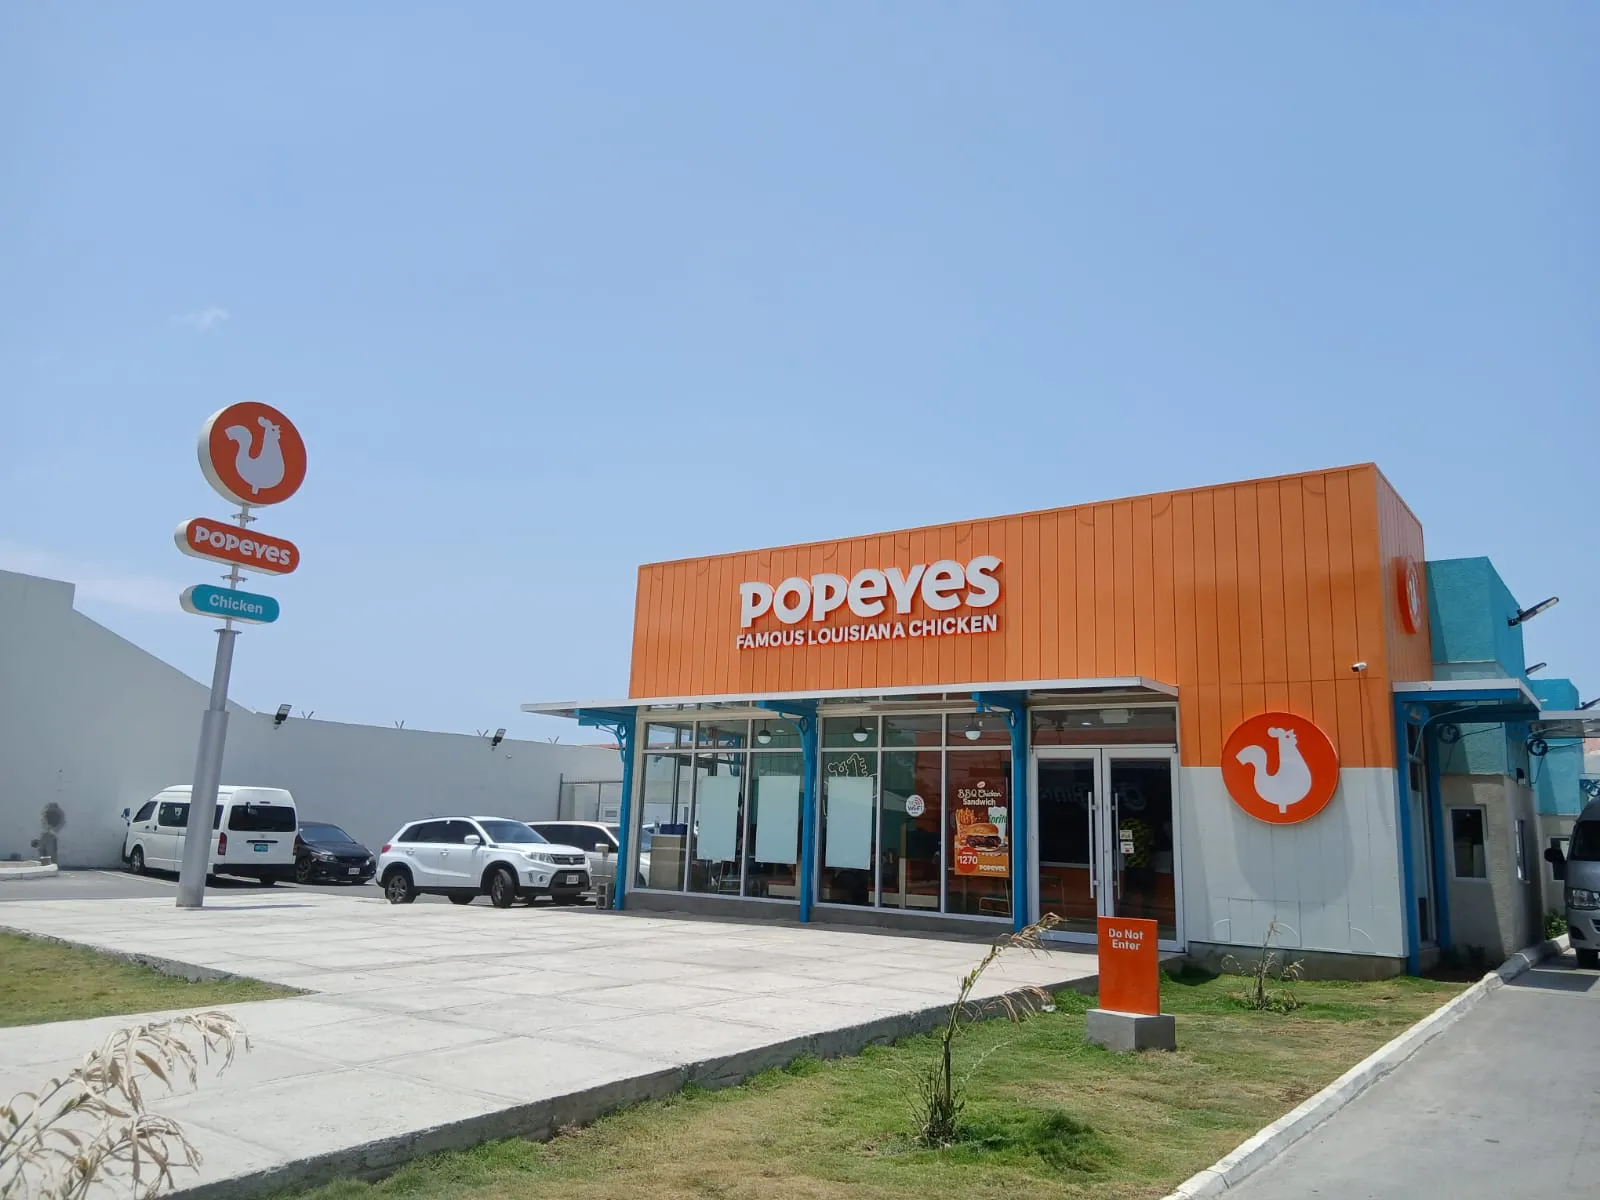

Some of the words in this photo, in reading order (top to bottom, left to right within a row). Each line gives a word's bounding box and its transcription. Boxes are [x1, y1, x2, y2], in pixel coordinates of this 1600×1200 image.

[209, 593, 264, 616] Chicken
[736, 629, 805, 650] FAMOUS
[807, 621, 906, 645] LOUISIANA
[909, 614, 998, 636] CHICKEN
[963, 798, 996, 806] Sandwich
[1109, 928, 1122, 937] Do
[1124, 928, 1144, 940] Not
[1112, 939, 1140, 950] Enter
